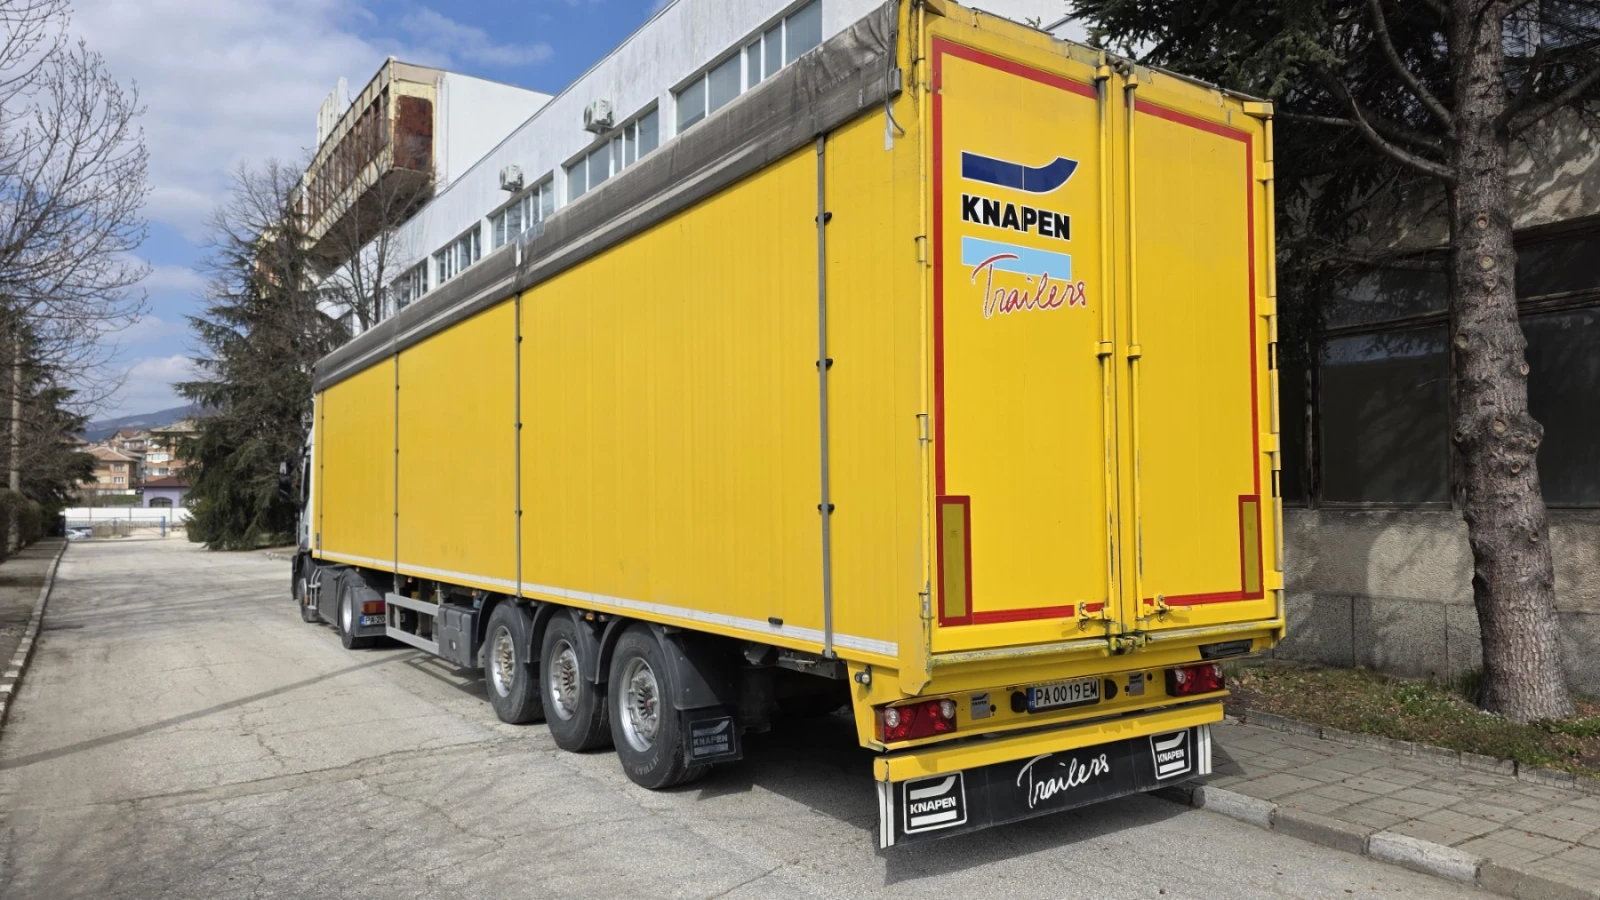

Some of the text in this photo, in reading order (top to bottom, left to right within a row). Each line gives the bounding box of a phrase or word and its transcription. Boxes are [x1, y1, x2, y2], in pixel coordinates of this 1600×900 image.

[961, 193, 1071, 241] KNAPEN
[971, 253, 1087, 319] Trailers
[1035, 680, 1098, 706] PA 0019 EM
[693, 734, 728, 747] KNAPEN
[1157, 748, 1185, 763] KNAPEN
[1017, 753, 1109, 809] Trailers
[910, 796, 957, 814] KNAPEN
